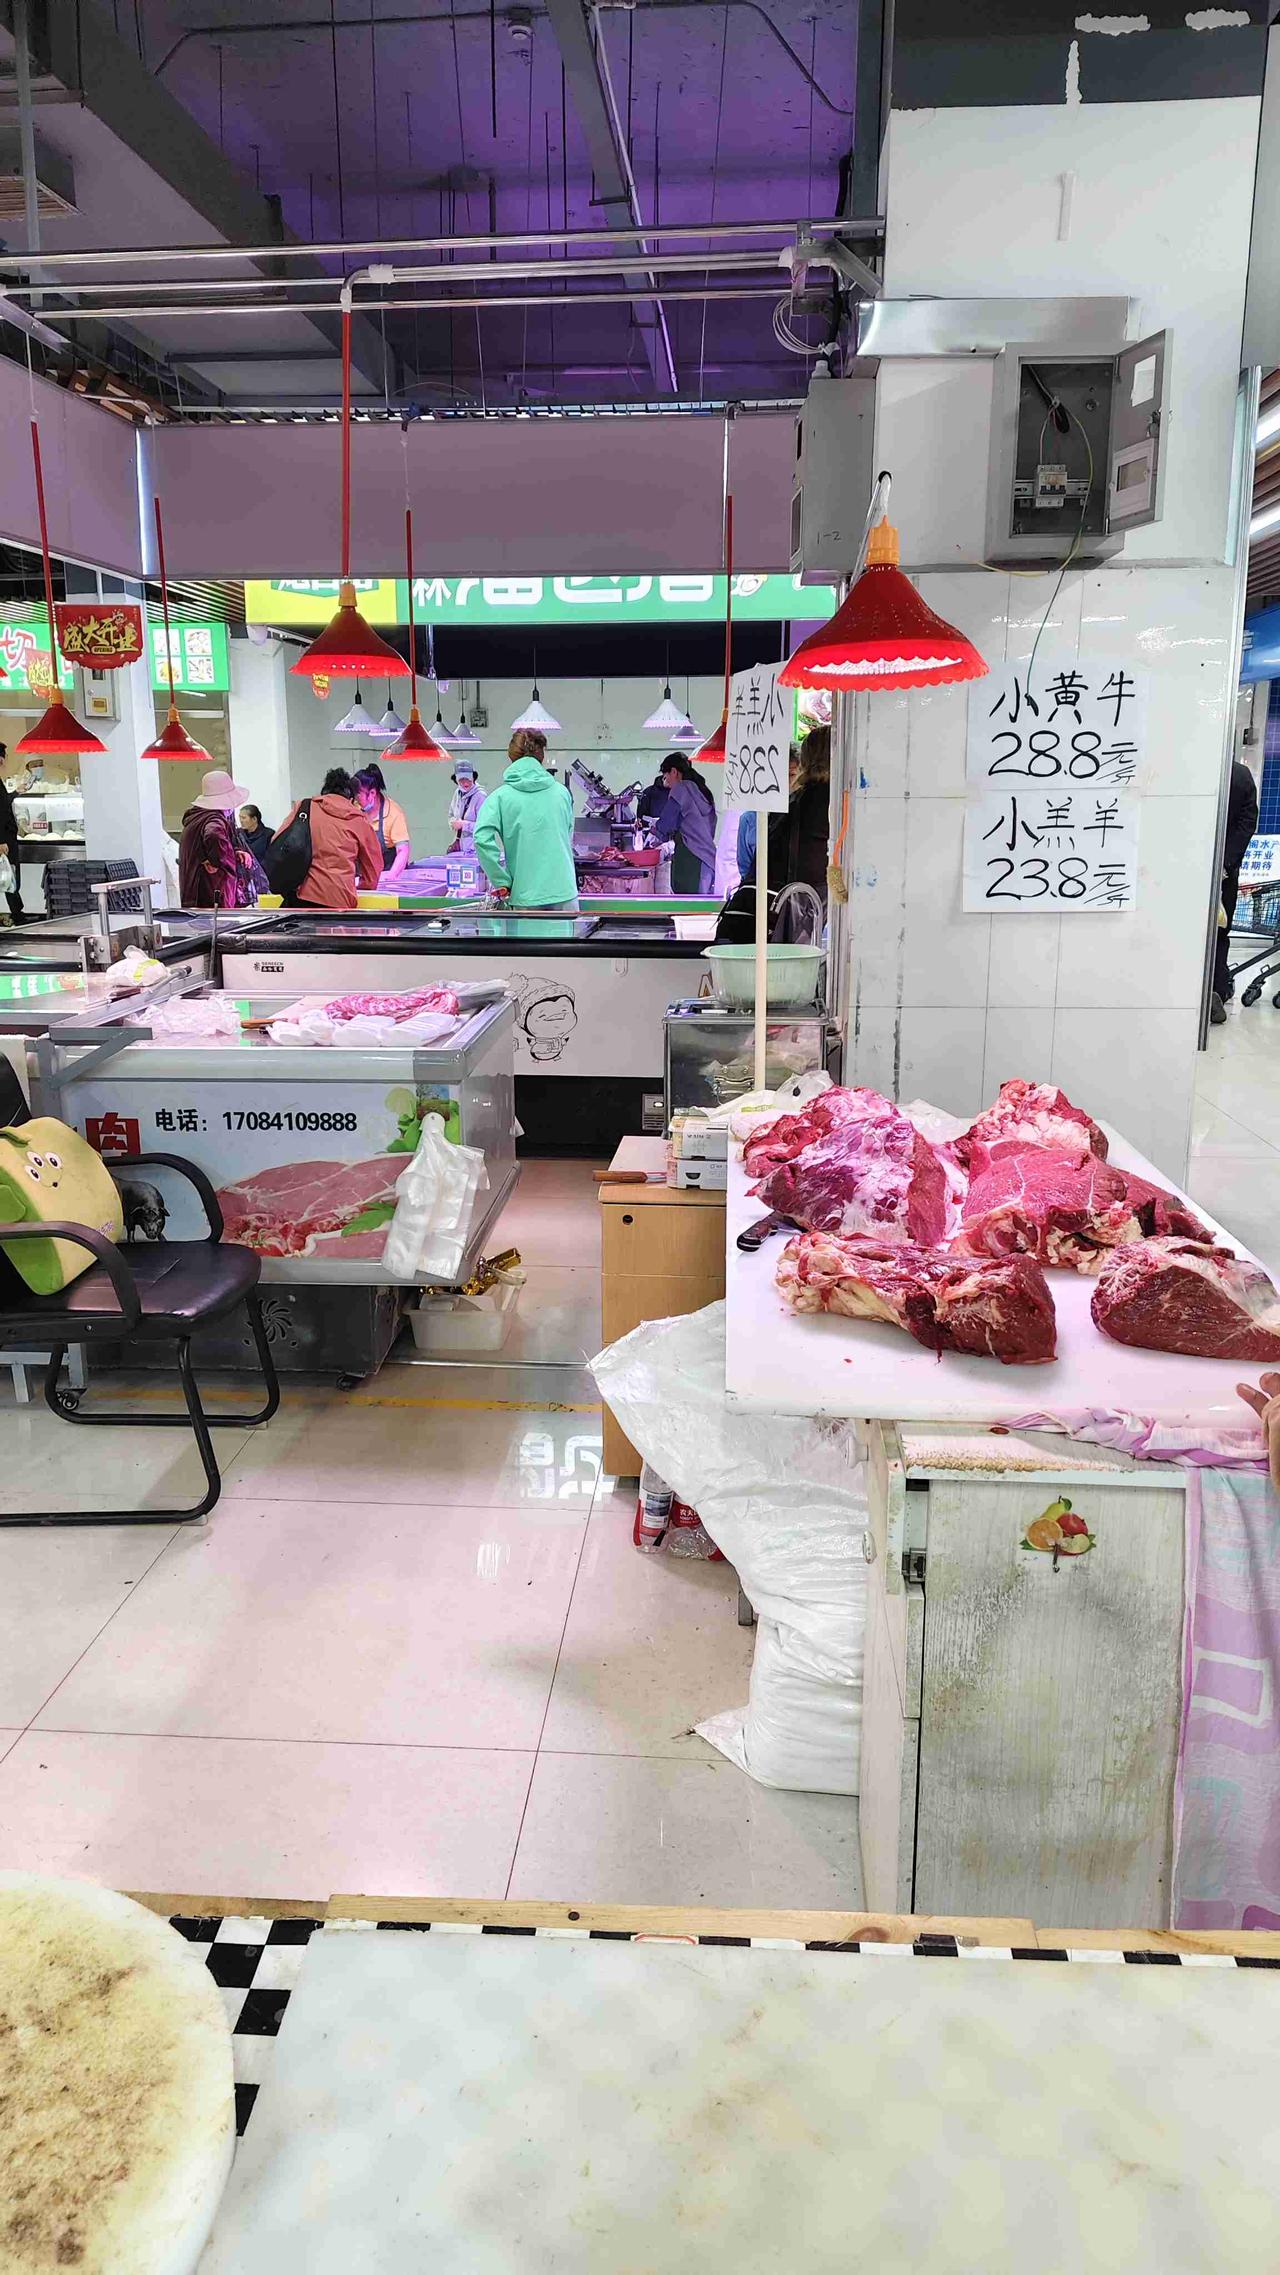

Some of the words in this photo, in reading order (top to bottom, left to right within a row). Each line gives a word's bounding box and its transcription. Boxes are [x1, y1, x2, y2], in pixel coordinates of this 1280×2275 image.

[63, 615, 139, 653] 盛大开业
[989, 669, 1136, 727] 小黄牛
[982, 796, 1124, 851] 小羔羊
[222, 1111, 357, 1131] 17084109888
